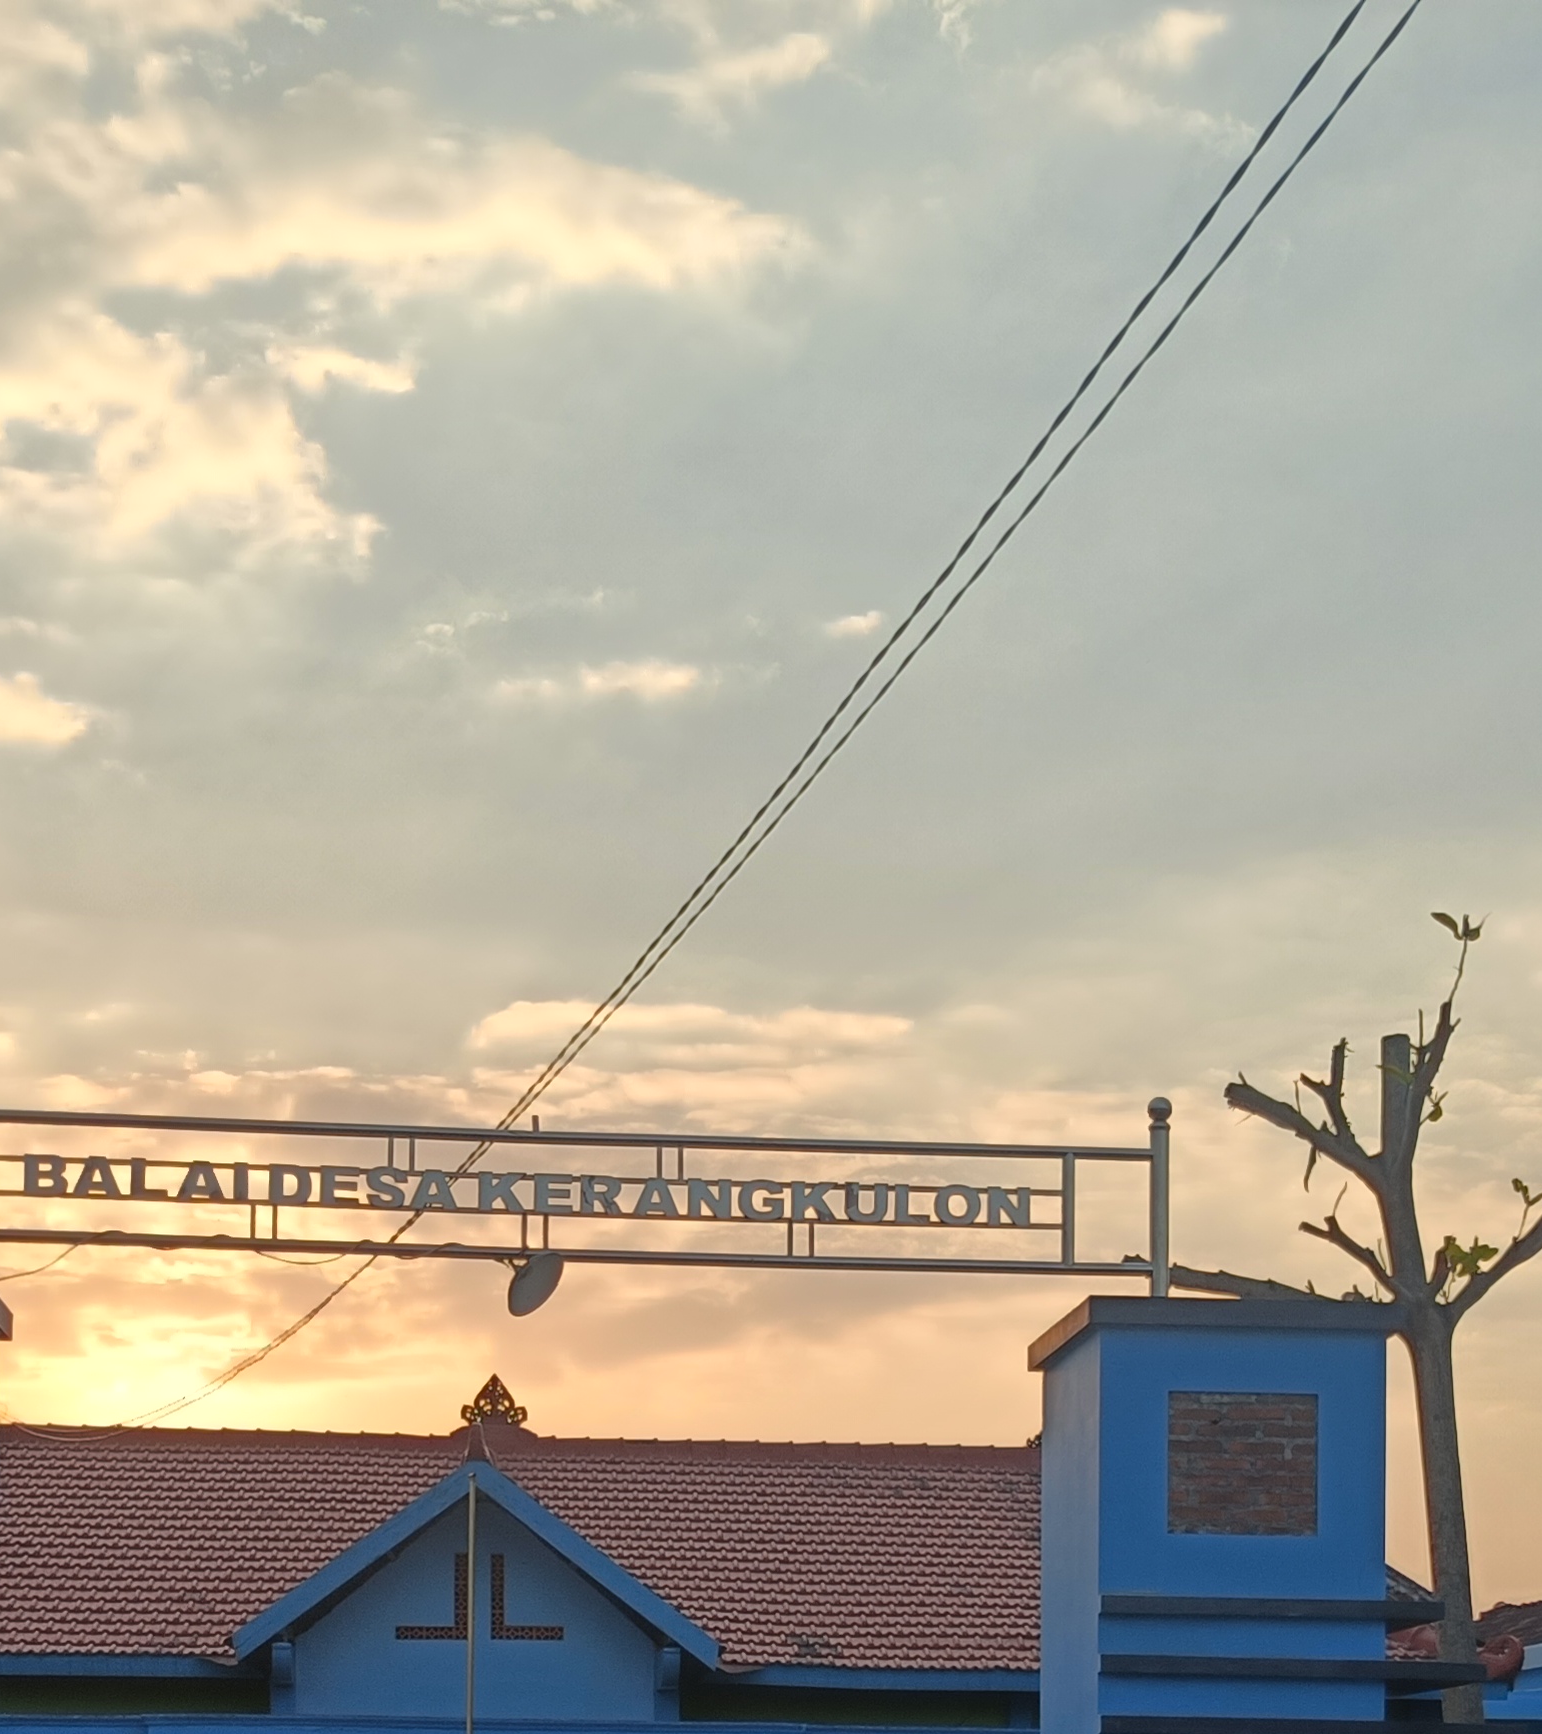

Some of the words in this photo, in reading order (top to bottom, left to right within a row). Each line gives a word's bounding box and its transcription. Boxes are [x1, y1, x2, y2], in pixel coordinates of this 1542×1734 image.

[23, 1153, 249, 1201] BALAI
[268, 1163, 458, 1210] DESA
[477, 1170, 1031, 1227] KERANGKULON
